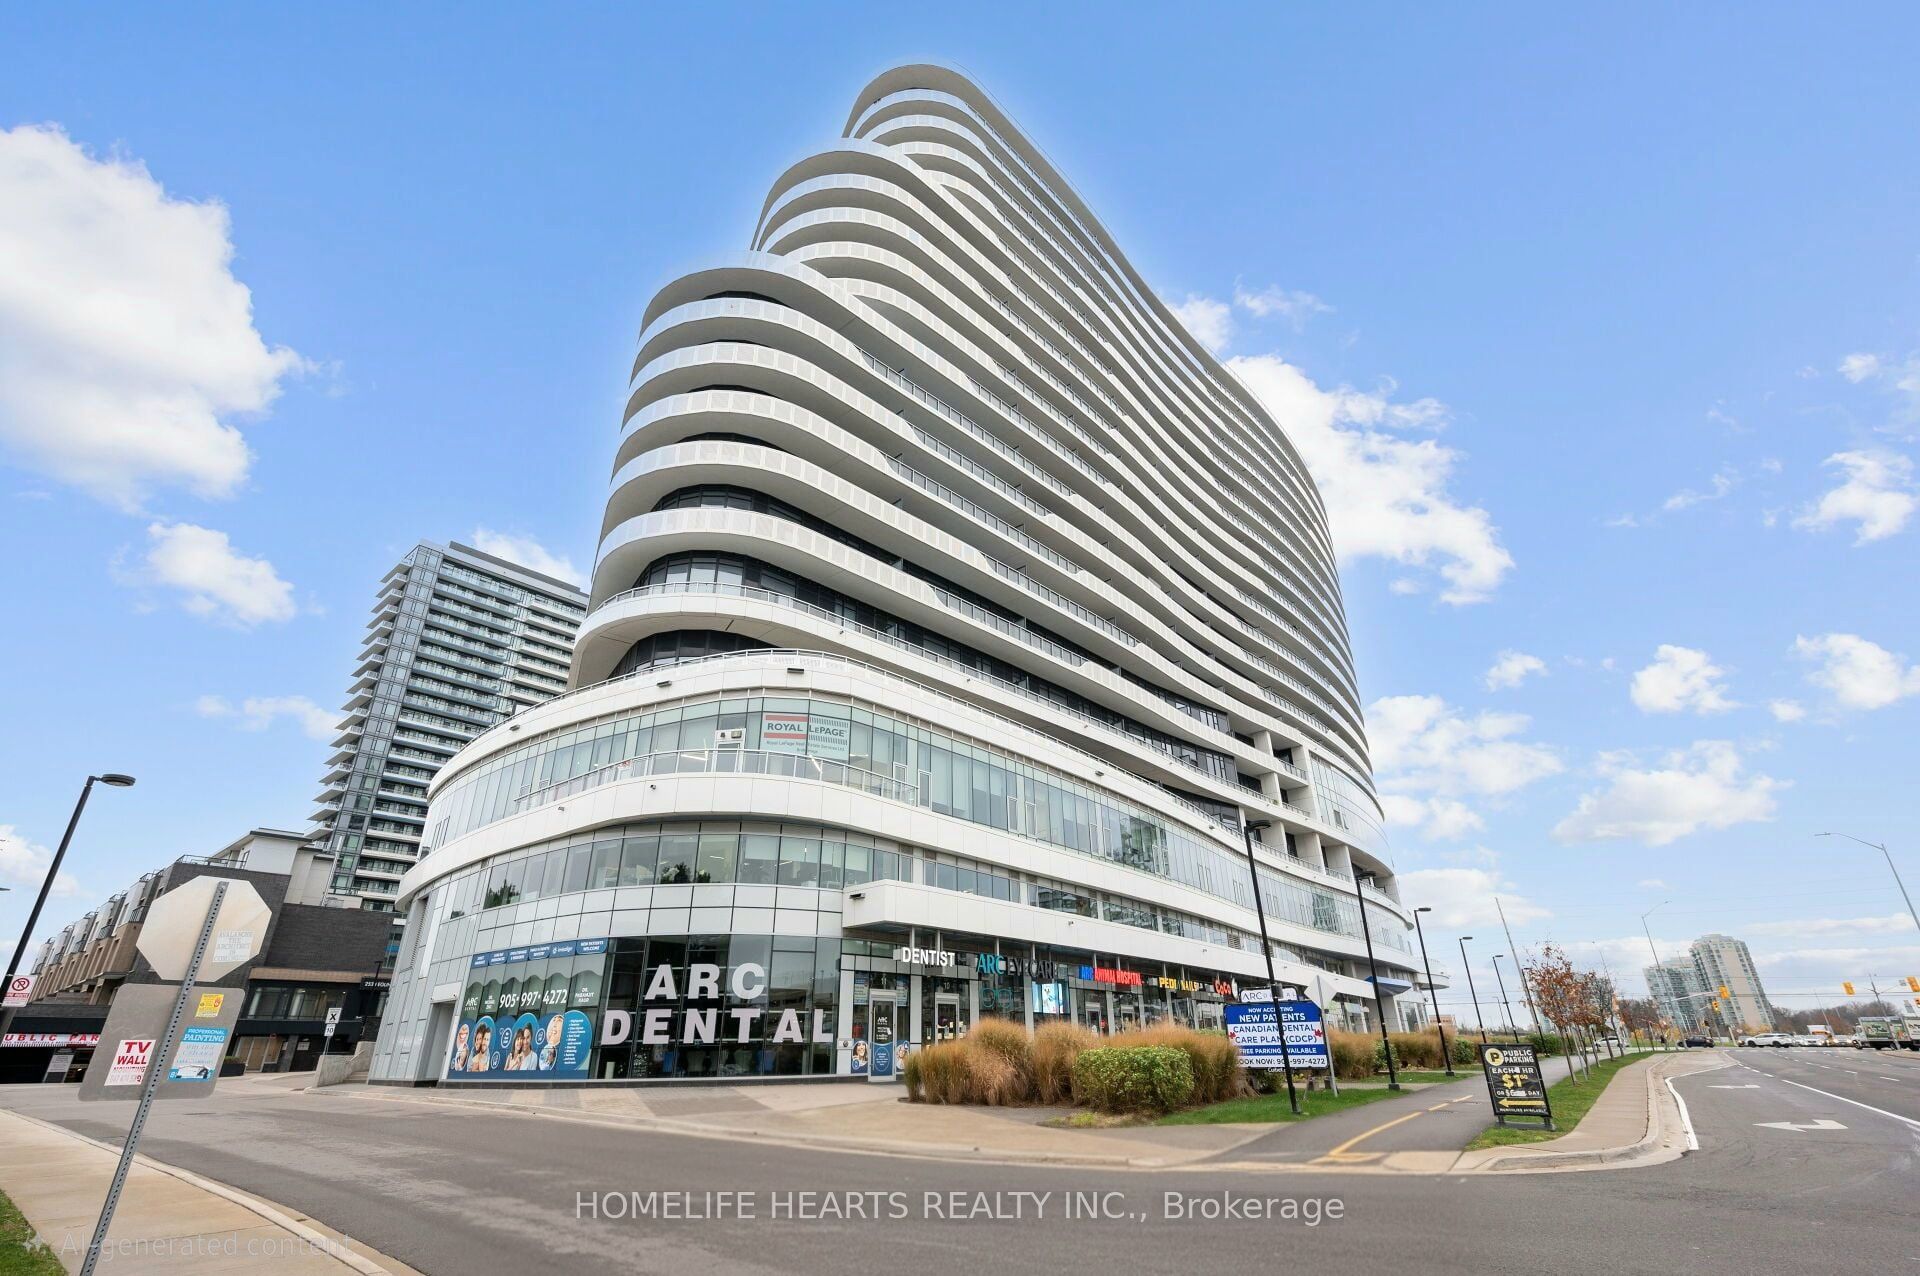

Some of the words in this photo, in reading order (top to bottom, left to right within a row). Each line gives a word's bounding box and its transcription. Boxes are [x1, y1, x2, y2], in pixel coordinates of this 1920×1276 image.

[767, 722, 803, 732] ROYAL
[902, 947, 955, 967] DENTIST
[978, 953, 1005, 975] ARC
[645, 963, 765, 1000] ARC
[1094, 967, 1116, 982] ANIMAL
[1116, 971, 1143, 985] HOSPITAL
[1159, 977, 1176, 990] PEDI
[1243, 992, 1262, 1000] ARC
[329, 1013, 337, 1021] X
[1239, 1014, 1260, 1022] NEW
[1263, 1013, 1306, 1022] PATENTS
[601, 1008, 834, 1045] DENTAL
[1233, 1025, 1278, 1033] CANADIAN
[1282, 1024, 1316, 1032] DENTAL
[1260, 1035, 1281, 1043] PLAN
[1286, 1035, 1317, 1043] (CDCP)
[125, 1041, 152, 1053] TV
[117, 1056, 147, 1065] WALL
